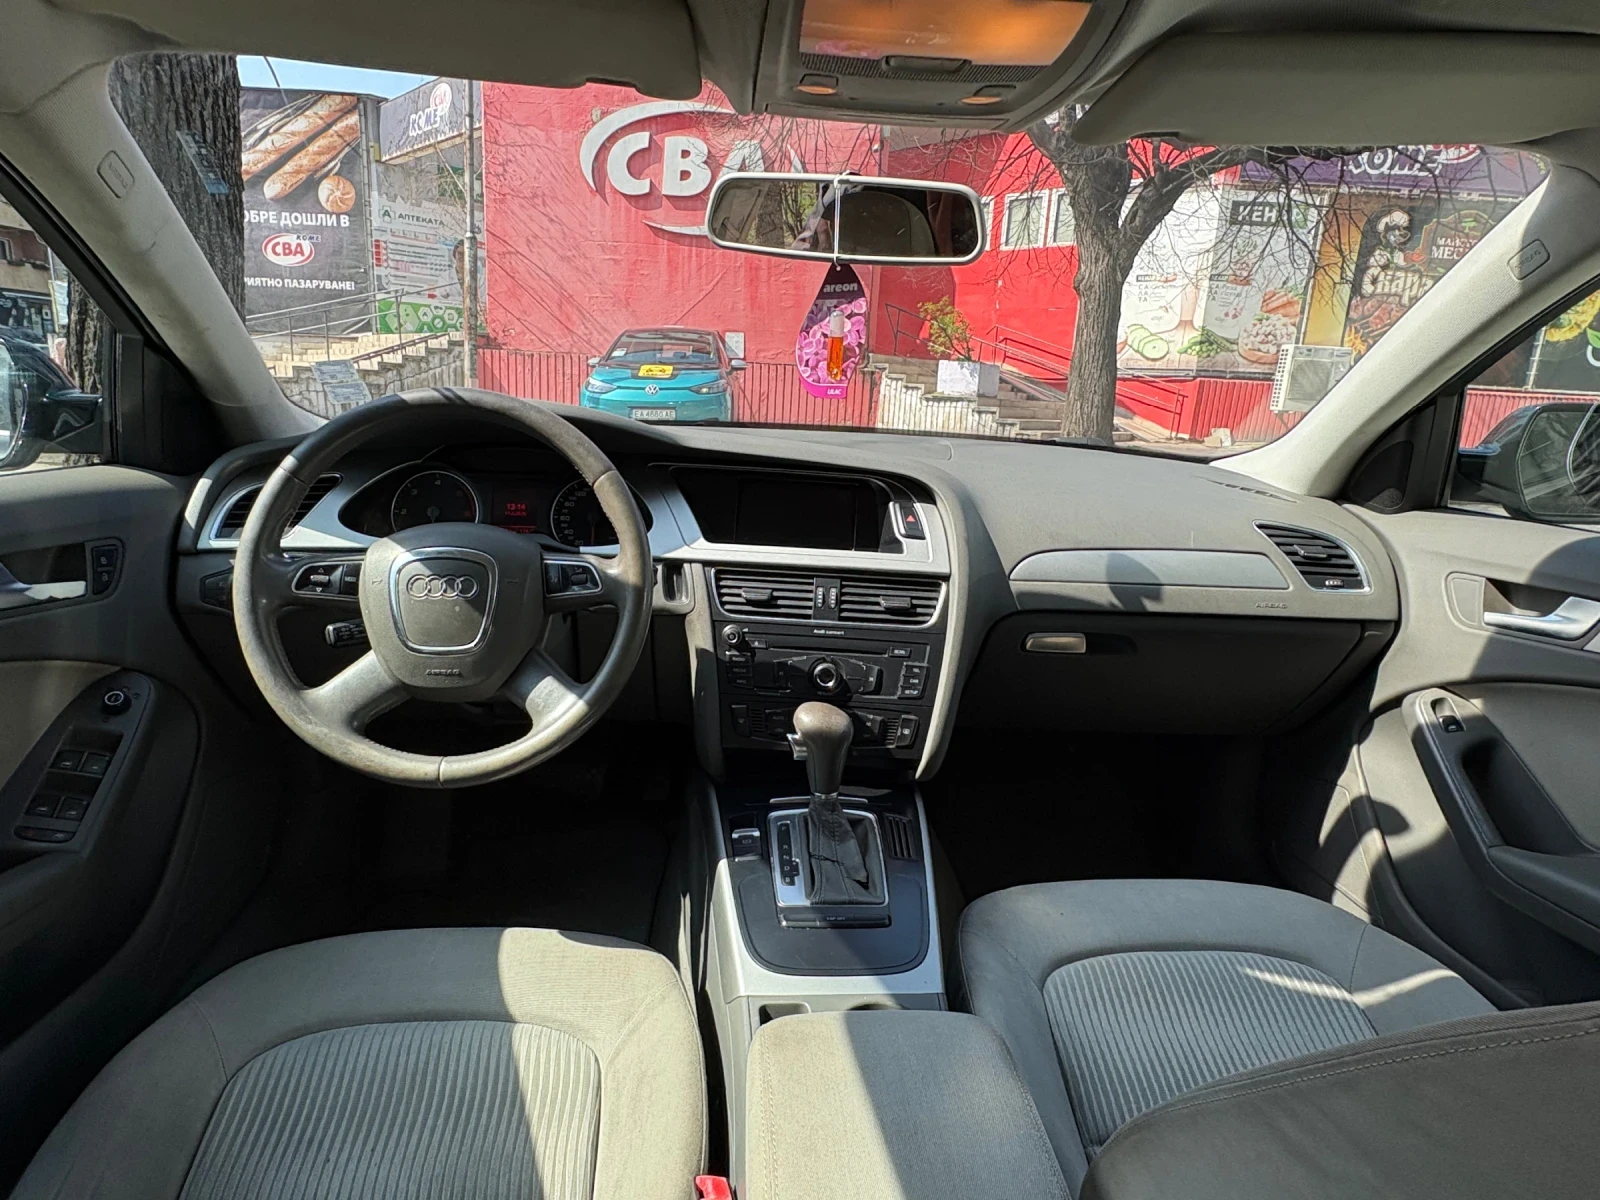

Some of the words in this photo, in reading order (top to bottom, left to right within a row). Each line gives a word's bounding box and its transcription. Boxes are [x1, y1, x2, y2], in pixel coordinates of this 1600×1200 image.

[244, 210, 277, 224] ОБРЕ
[280, 211, 338, 228] ДОШЛИ
[340, 214, 350, 227] В
[397, 212, 446, 227] АПТЕКАТА
[1431, 245, 1470, 260] МЕС
[244, 276, 283, 288] ИЯТНО
[285, 279, 355, 291] ПАЗАРУВАНЕ!
[823, 282, 858, 293] areon
